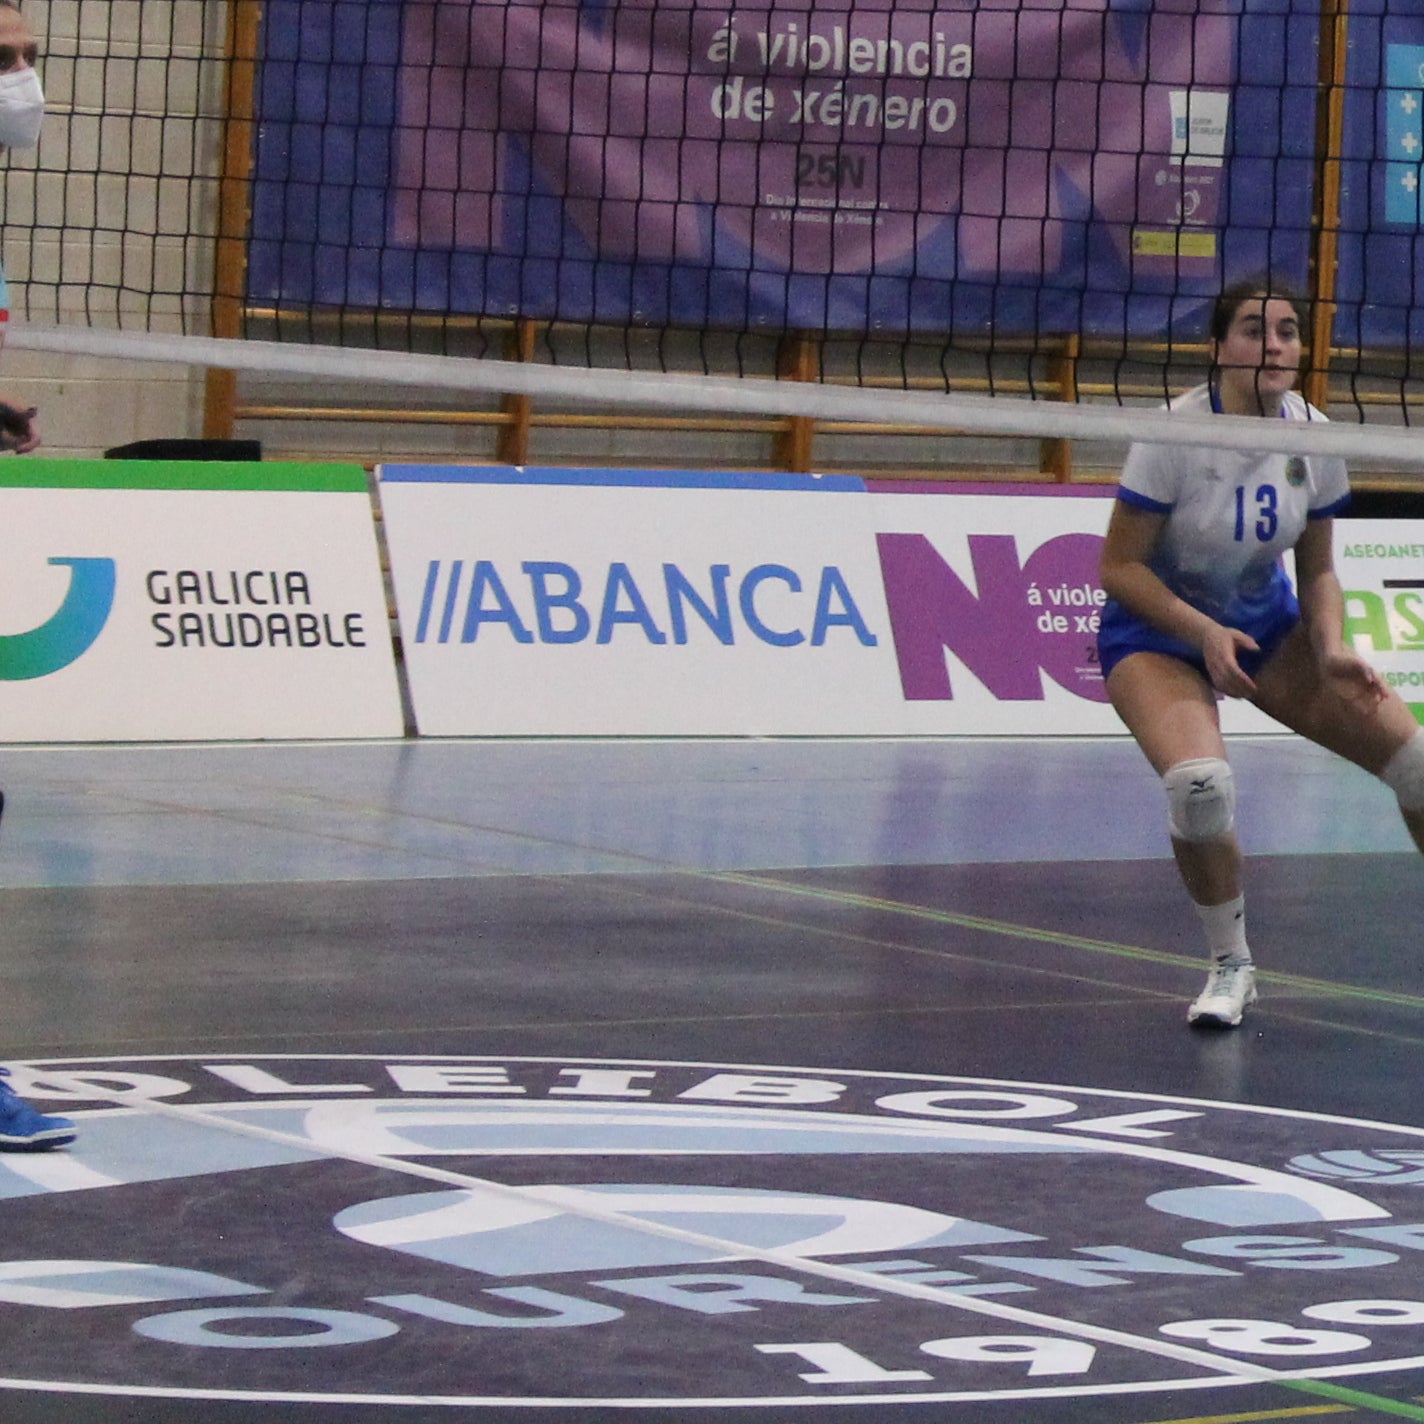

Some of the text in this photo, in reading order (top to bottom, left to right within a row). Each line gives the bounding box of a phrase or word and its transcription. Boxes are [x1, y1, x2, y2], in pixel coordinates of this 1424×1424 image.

[707, 17, 974, 78] á violencia
[710, 76, 957, 133] de xénero
[795, 152, 866, 191] 25N
[1233, 484, 1278, 543] 13
[146, 570, 310, 606] GALICIA
[1027, 582, 1043, 606] á
[153, 612, 367, 649] SAUDABLE
[1037, 610, 1069, 633] de
